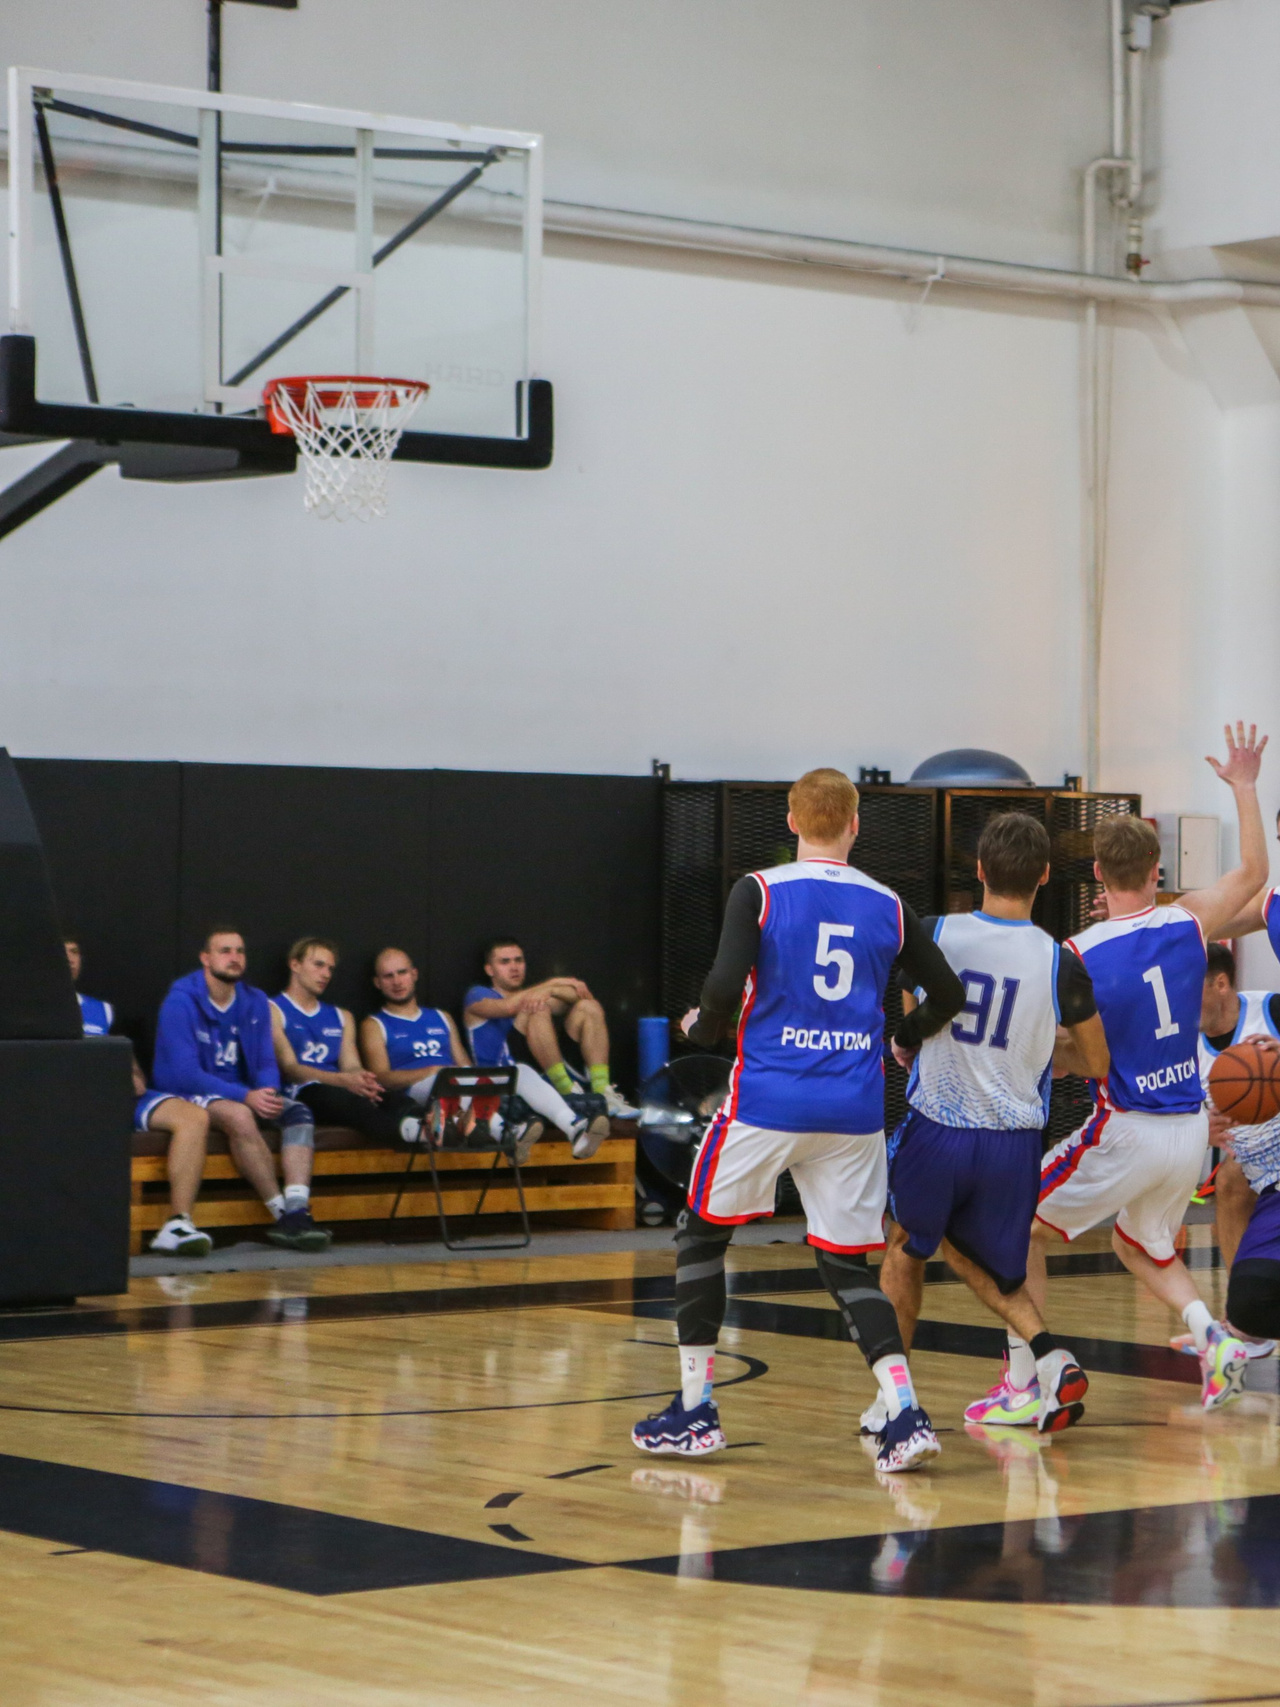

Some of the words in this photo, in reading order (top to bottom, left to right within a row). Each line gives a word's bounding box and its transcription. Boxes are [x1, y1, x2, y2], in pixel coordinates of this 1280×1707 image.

[813, 922, 855, 1002] 5
[781, 1026, 872, 1051] РОСАТОМ
[950, 968, 1021, 1051] 91
[1142, 965, 1180, 1040] 1
